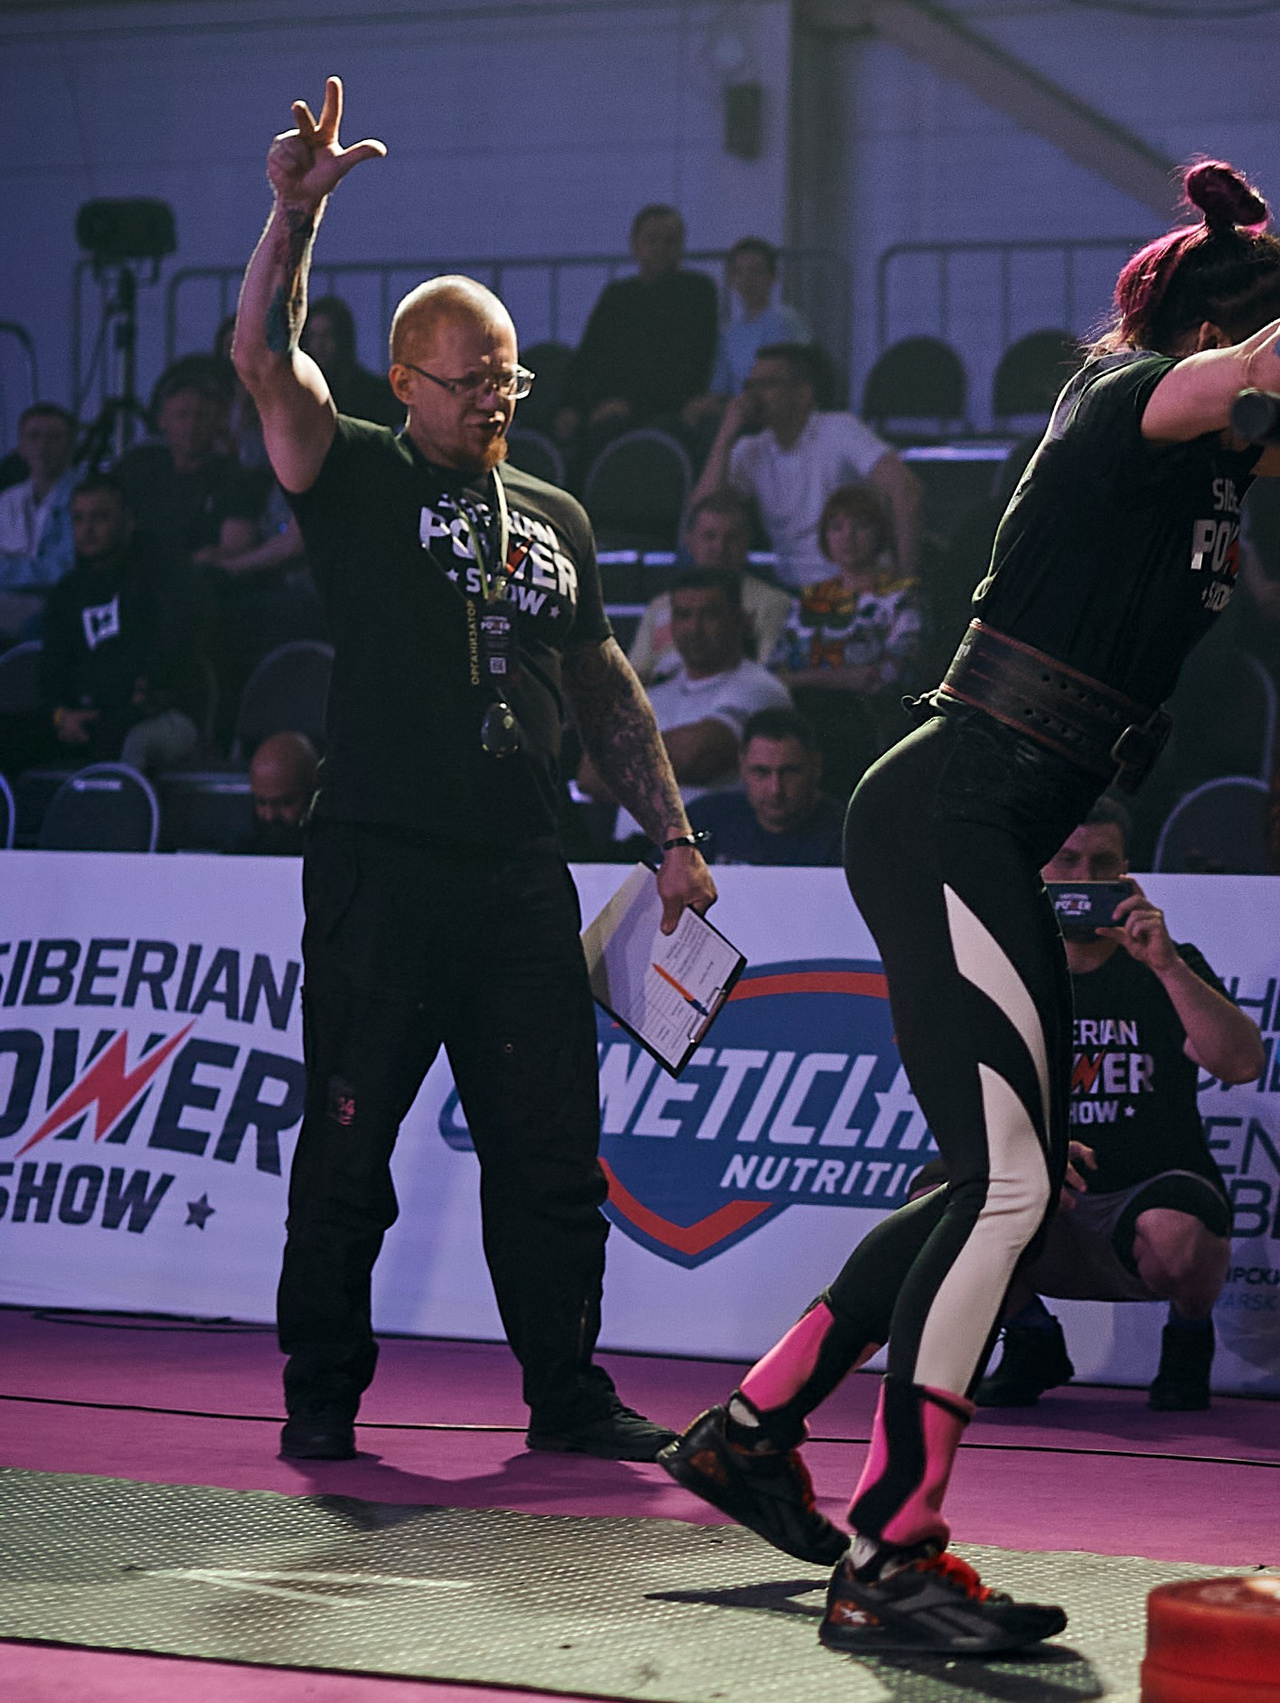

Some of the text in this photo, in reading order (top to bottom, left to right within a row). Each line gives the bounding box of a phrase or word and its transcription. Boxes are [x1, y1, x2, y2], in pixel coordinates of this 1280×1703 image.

[0, 938, 300, 1031] IBERIAN
[0, 1028, 306, 1177] OWER
[720, 1154, 923, 1198] NUTRITI
